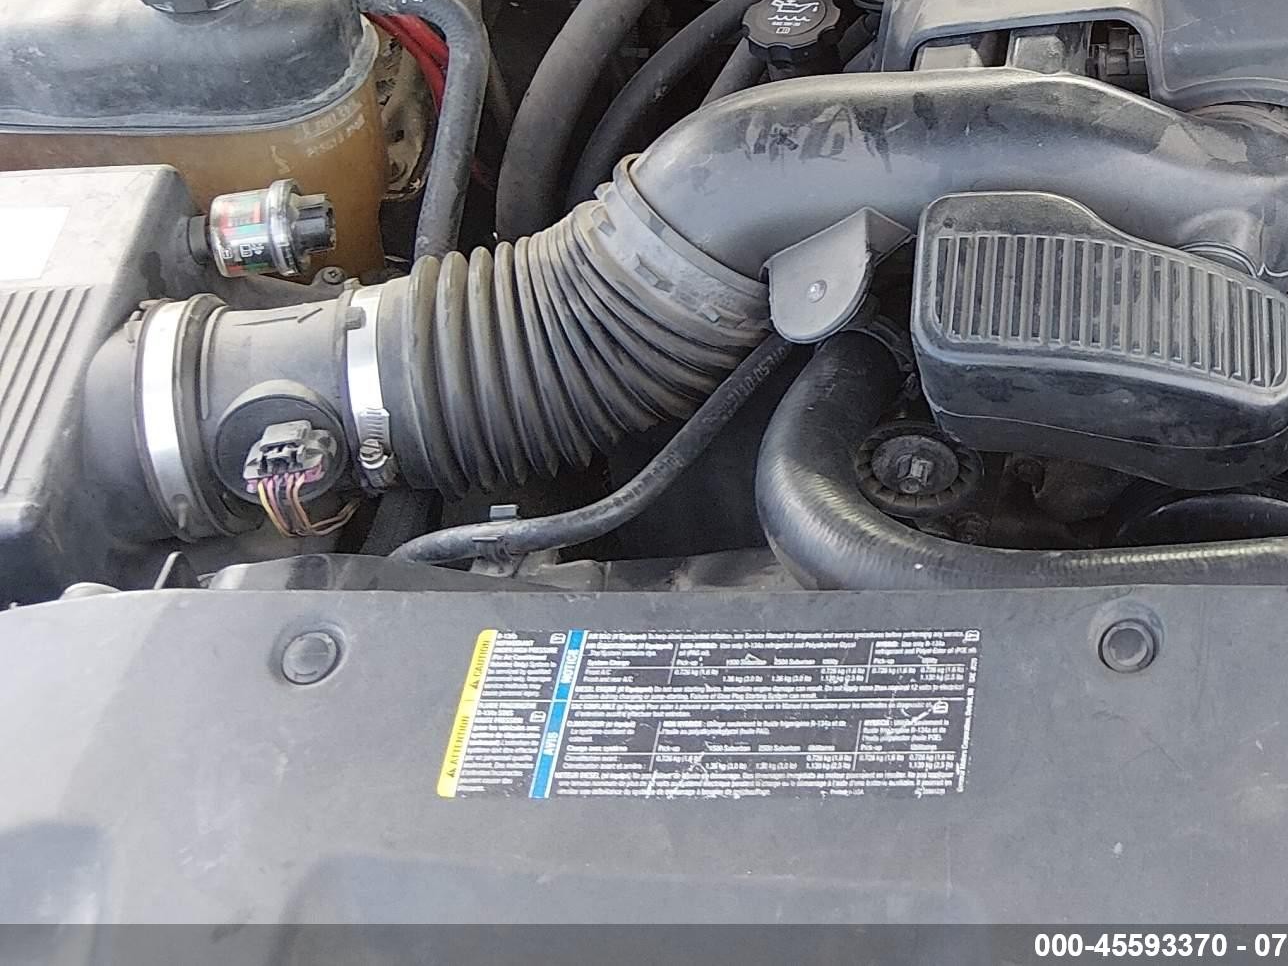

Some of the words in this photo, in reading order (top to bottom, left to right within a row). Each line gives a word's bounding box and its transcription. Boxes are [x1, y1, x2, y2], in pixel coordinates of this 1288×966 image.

[473, 640, 491, 678] CAUTION
[560, 649, 580, 684] NOTICE
[451, 715, 471, 763] ATTENTION
[543, 731, 559, 756] AVIS
